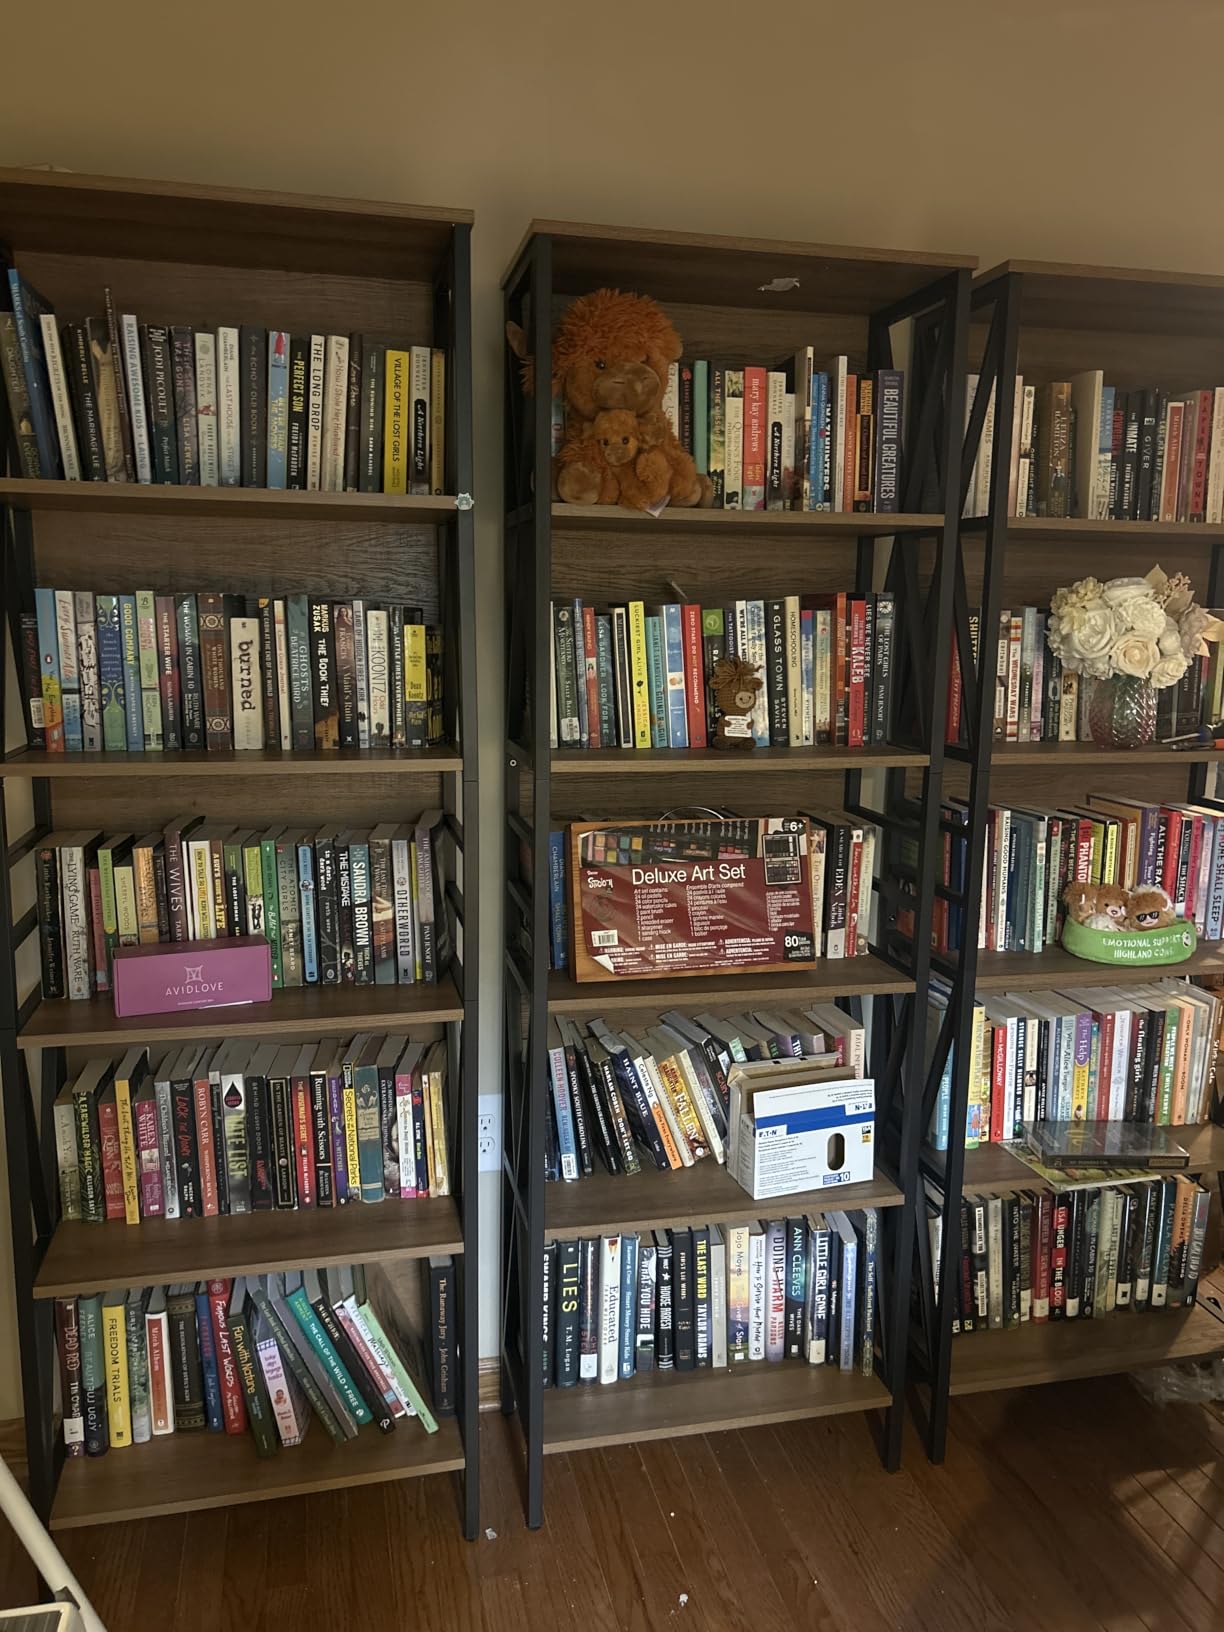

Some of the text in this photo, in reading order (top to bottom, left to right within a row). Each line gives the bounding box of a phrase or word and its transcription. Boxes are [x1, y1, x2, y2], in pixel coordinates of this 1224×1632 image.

[153, 344, 168, 414] JODI PICOULT
[292, 360, 305, 412] PERFECT SON
[311, 342, 322, 430] THE LONG DROP
[394, 358, 402, 389] VILLAGE
[393, 391, 401, 402] OF
[393, 404, 401, 419] THE
[750, 378, 763, 452] mary kay andrews
[83, 392, 100, 469] THE MARRIAGE LIE
[393, 420, 401, 439] LOST
[880, 389, 899, 498] BEAUTIFUL CREATURES
[1126, 422, 1138, 453] INMATE
[1143, 435, 1152, 469] GIVER
[123, 603, 135, 665] GOOD COMPANY
[162, 624, 171, 655] STARTER
[183, 616, 192, 645] WOMAN
[312, 604, 321, 632] ZUSAK
[321, 604, 330, 632] MARKUS
[865, 623, 871, 635] WE
[164, 656, 172, 675] WIFE
[185, 647, 193, 655] IN
[185, 656, 194, 680] CABIN
[290, 636, 301, 703] BEATRICE BIRD
[299, 645, 309, 692] GHOSTS
[317, 638, 329, 707] THE BOOK THIEF
[371, 650, 385, 693] KOONTZ
[773, 615, 784, 691] GLASS TOWN
[851, 646, 864, 684] KALEB
[187, 680, 195, 689] 10
[238, 640, 255, 711] burned
[1010, 659, 1019, 697] WEDNESDAY
[789, 821, 804, 831] 6+
[1156, 825, 1167, 867] ALL THE
[169, 844, 183, 912] THE WIVES
[340, 850, 351, 907] THE MISTAKE
[631, 867, 687, 886] Deluxe
[690, 865, 715, 882] Art
[718, 863, 747, 880] Set
[834, 868, 845, 896] EDEN
[1078, 842, 1090, 883] PHANTO
[67, 863, 80, 924] LYING GAME
[353, 862, 369, 946] SANDRA BROWN
[1177, 876, 1187, 903] SHACK
[1211, 863, 1224, 922] SHALL SLEEP
[396, 890, 410, 957] OTHERWORLD
[784, 936, 799, 947] 80
[1114, 949, 1152, 959] HIGHLAND
[166, 982, 224, 996] AVIDLOVE
[996, 1043, 1005, 1086] McGILLOWAY
[1078, 1040, 1087, 1060] Help
[1134, 1030, 1145, 1063] floating
[623, 1058, 648, 1118] HAINT BLUE
[1133, 1064, 1143, 1083] girls
[1163, 1072, 1171, 1092] EMILY
[138, 1114, 147, 1148] WHITE
[147, 1112, 156, 1145] KAREN
[197, 1087, 209, 1144] ROBYN CARR
[313, 1077, 327, 1160] Running with Scissors
[603, 1064, 634, 1161] HARLAN COBEN DON'T LET GO
[345, 1090, 358, 1185] Secrets National Parks
[227, 1150, 247, 1176] LIST
[736, 1231, 744, 1277] Jojo Moyes
[1056, 1224, 1064, 1248] UNGER
[772, 1237, 785, 1313] DOING HARM
[792, 1227, 802, 1296] ANN CLEEVES
[816, 1237, 829, 1320] LITTLE GIRL GONE
[1055, 1266, 1063, 1281] THE
[1056, 1256, 1063, 1265] IN
[561, 1263, 578, 1313] LIES
[640, 1261, 651, 1329] WHAT YOU HIDE
[660, 1285, 671, 1329] HOUSE ARREST
[697, 1239, 708, 1359] THE LAST WORD TAYLOR ADAMS
[1054, 1282, 1062, 1306] BLOOD
[87, 1313, 96, 1339] ALICE
[438, 1277, 449, 1393] The Runaway Jury John Grisham
[607, 1285, 619, 1344] Educated
[64, 1326, 80, 1371] DEAD RED
[108, 1318, 122, 1403] FREEDOM TRIALS
[214, 1300, 234, 1388] FAMOUS LAST WORDS
[231, 1325, 256, 1394] Fun with Nature
[309, 1323, 358, 1407] THE CALL OF THE WILD FREE
[565, 1347, 573, 1372] Logan
